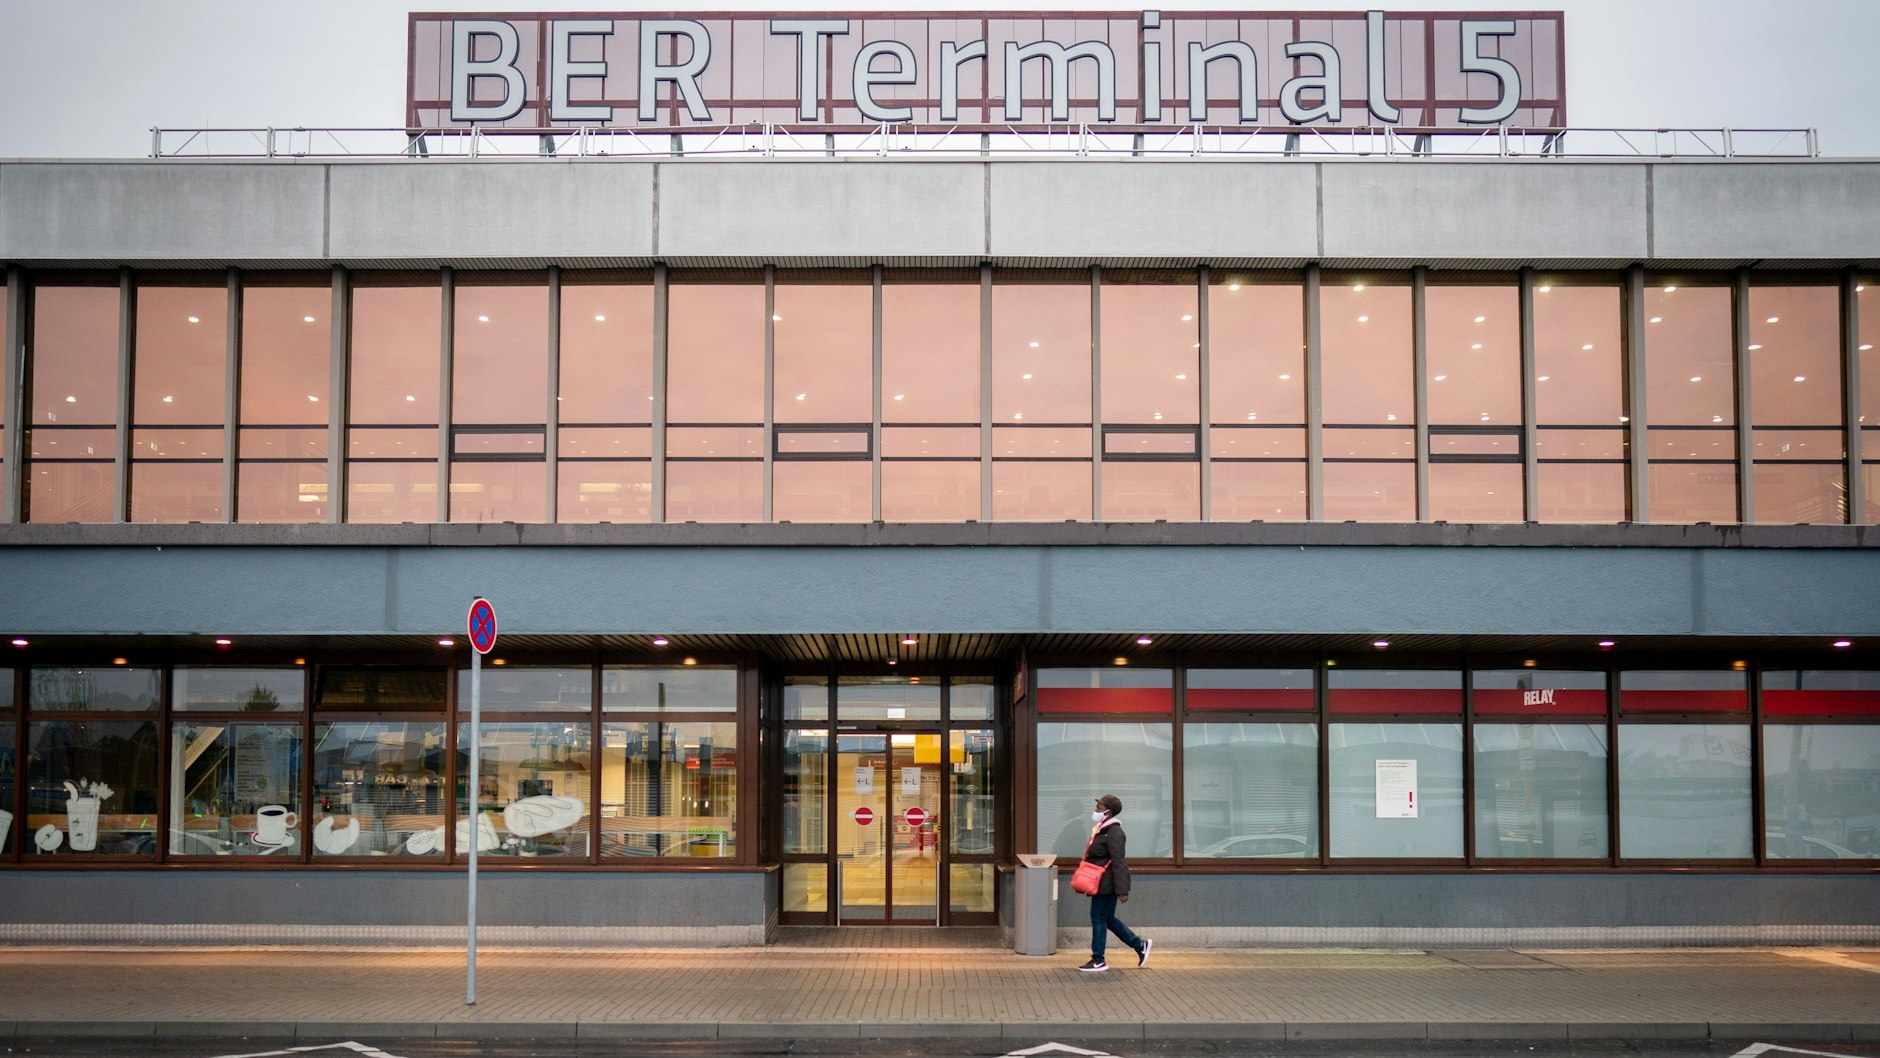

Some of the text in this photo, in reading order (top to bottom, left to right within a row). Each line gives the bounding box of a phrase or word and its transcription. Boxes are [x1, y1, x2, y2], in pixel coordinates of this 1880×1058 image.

[450, 9, 1523, 124] BER Terminal 5
